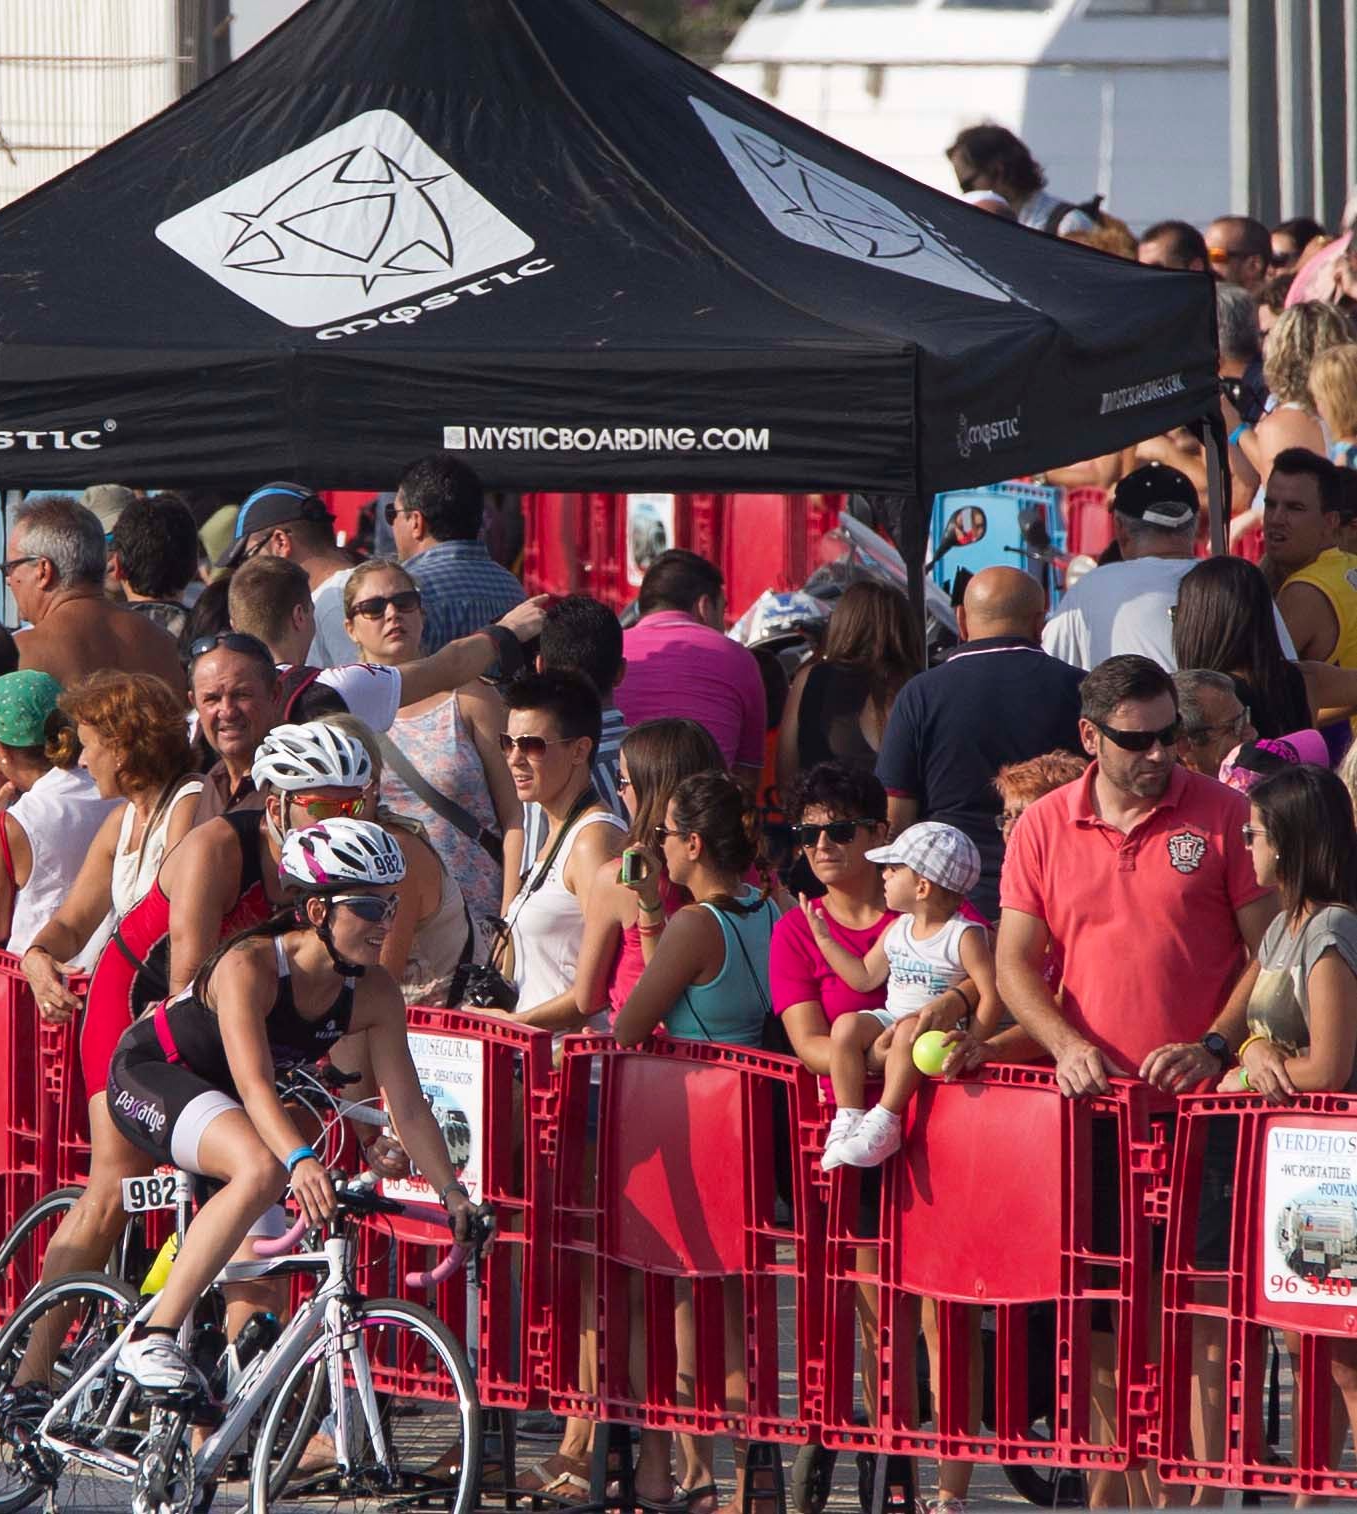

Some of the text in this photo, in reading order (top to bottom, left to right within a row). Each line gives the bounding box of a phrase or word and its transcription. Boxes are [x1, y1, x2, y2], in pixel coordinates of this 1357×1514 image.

[469, 426, 770, 451] MYSTICBOARDING.COM
[373, 853, 403, 876] 982
[129, 1176, 177, 1209] 982
[1270, 1273, 1352, 1297] 96 340
